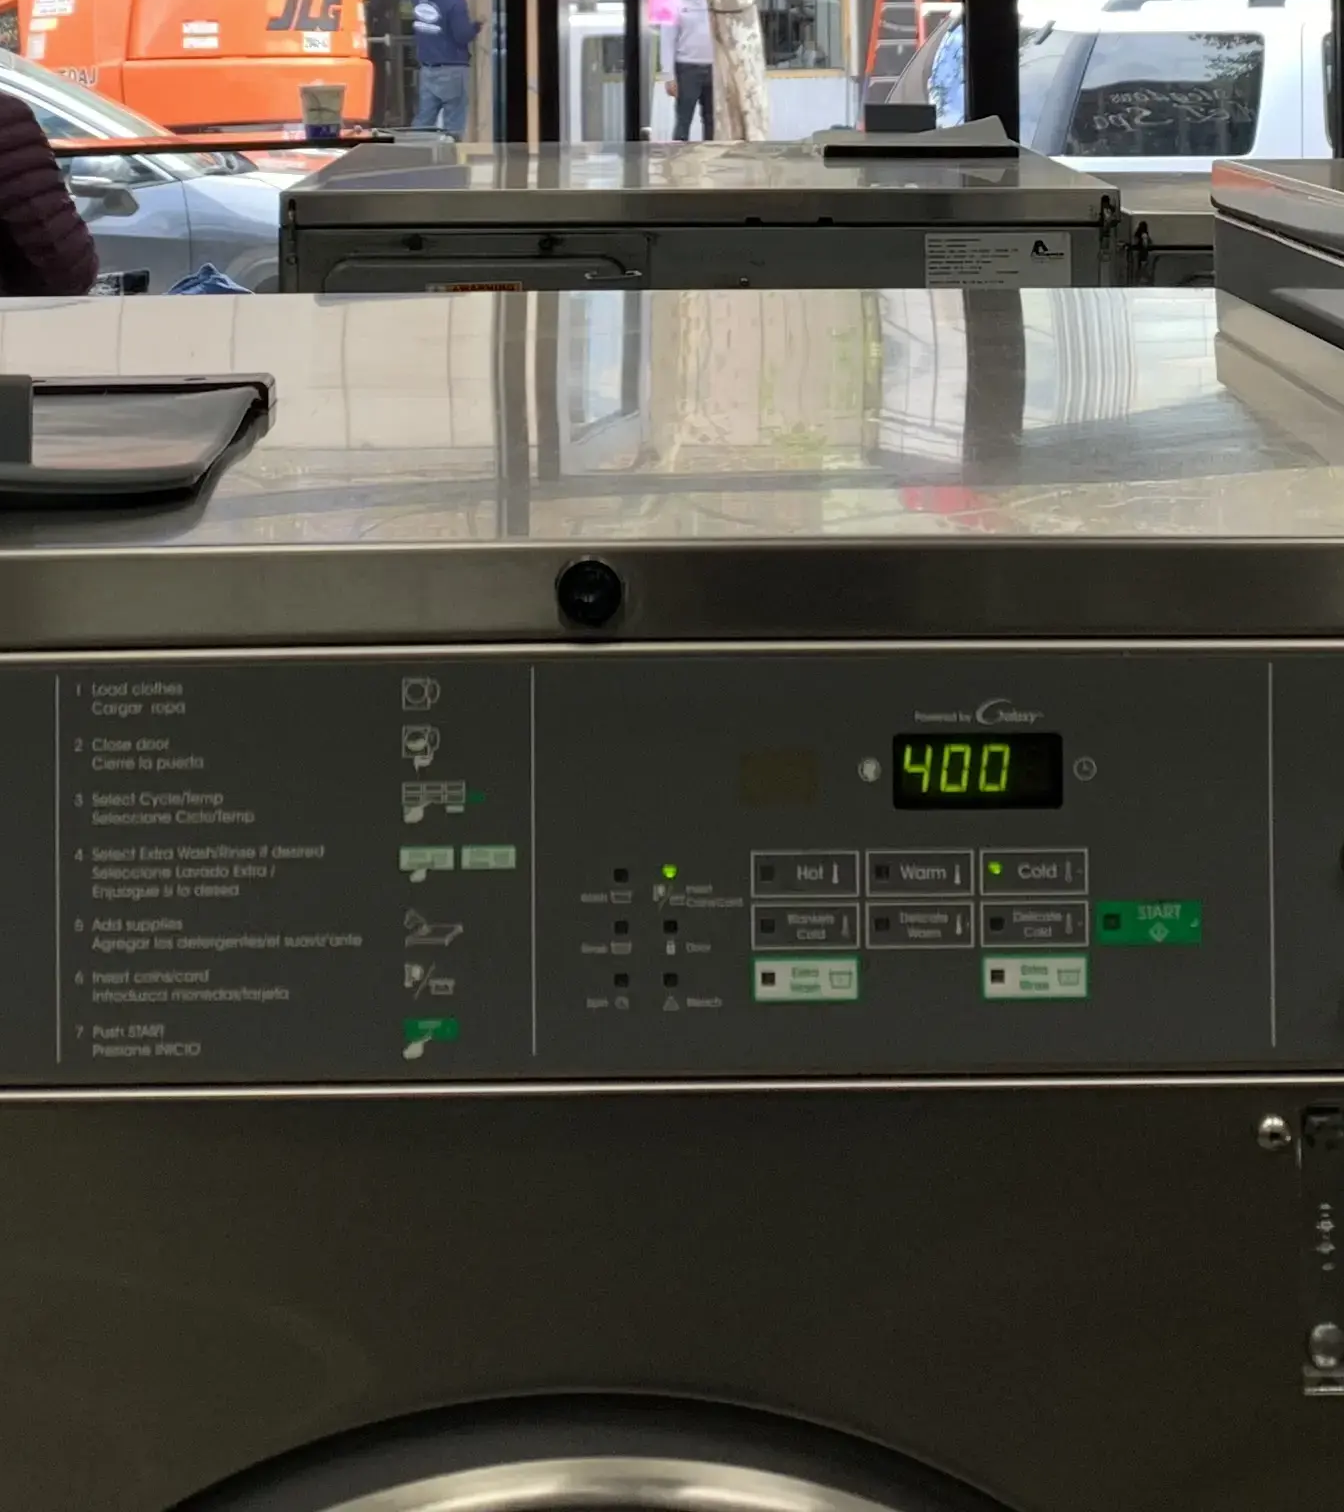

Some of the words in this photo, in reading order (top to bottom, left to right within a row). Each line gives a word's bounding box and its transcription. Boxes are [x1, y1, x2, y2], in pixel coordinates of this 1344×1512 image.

[92, 682, 128, 696] Load
[92, 701, 143, 718] Cargar
[151, 701, 186, 717] ropa
[74, 740, 83, 752] 2
[904, 744, 1010, 793] 400
[796, 864, 824, 880] Hot
[900, 864, 947, 880] Warm
[1017, 862, 1057, 880] Cold
[1137, 904, 1182, 920] START
